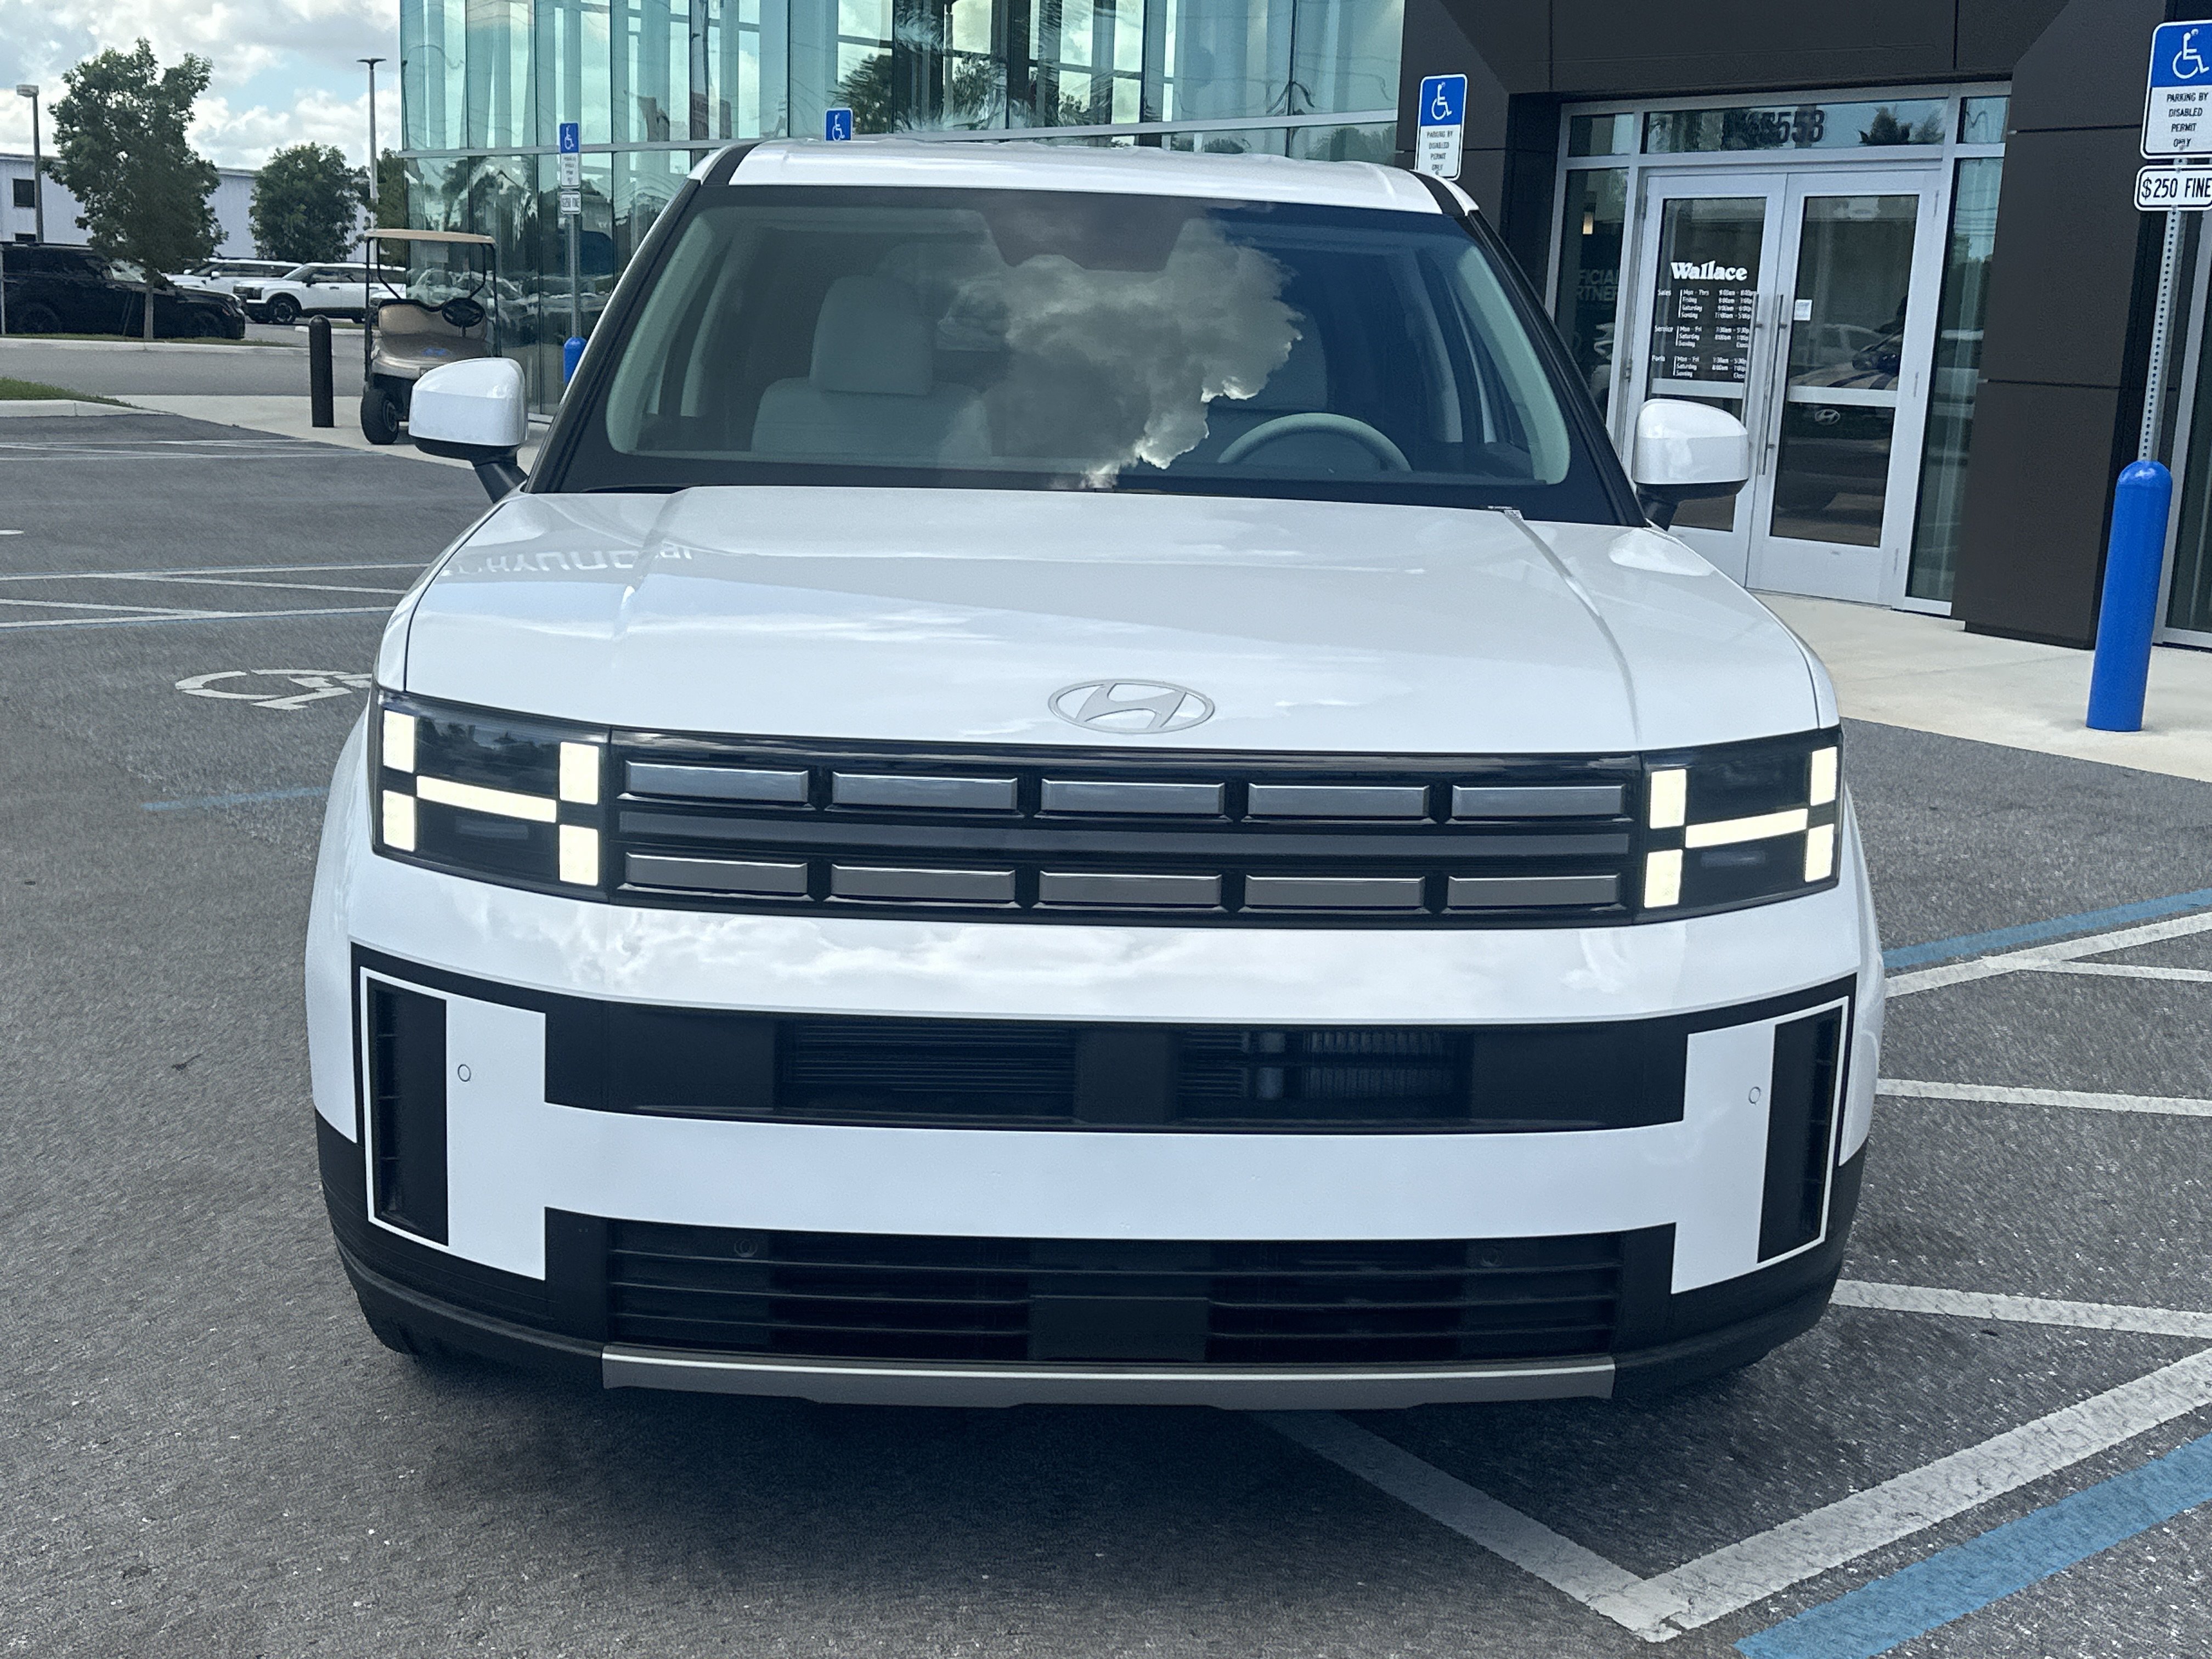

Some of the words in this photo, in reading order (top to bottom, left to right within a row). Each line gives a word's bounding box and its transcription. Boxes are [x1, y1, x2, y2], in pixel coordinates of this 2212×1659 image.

[2166, 93, 2196, 103] PARKING
[2198, 92, 2209, 101] BY
[2169, 108, 2203, 117] DISABLED
[2171, 123, 2197, 132] PERMIT
[2141, 177, 2178, 200] $250
[2185, 177, 2212, 198] FINE
[1671, 261, 1748, 281] Wallace
